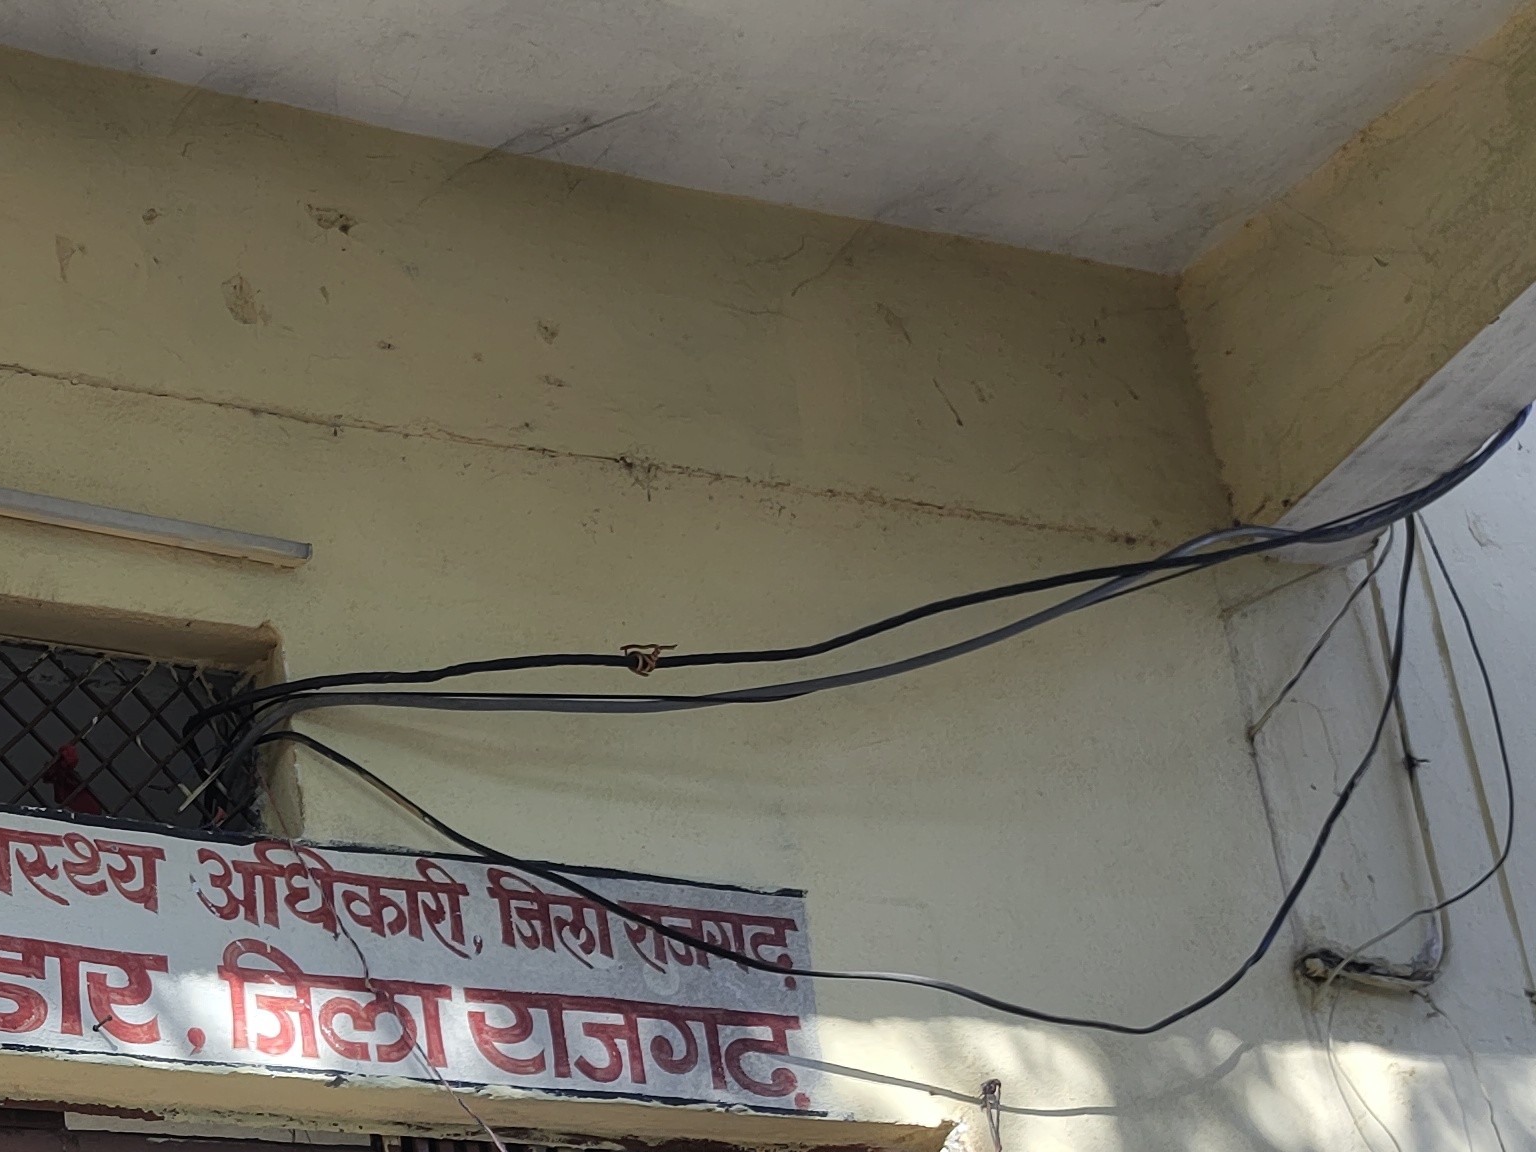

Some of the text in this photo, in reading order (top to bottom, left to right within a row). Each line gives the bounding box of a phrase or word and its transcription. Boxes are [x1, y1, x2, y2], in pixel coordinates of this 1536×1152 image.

[487, 867, 614, 970] जिला
[617, 900, 799, 990] राजगढ़
[216, 937, 453, 1069] जिला
[465, 986, 812, 1110] राजगढ़
